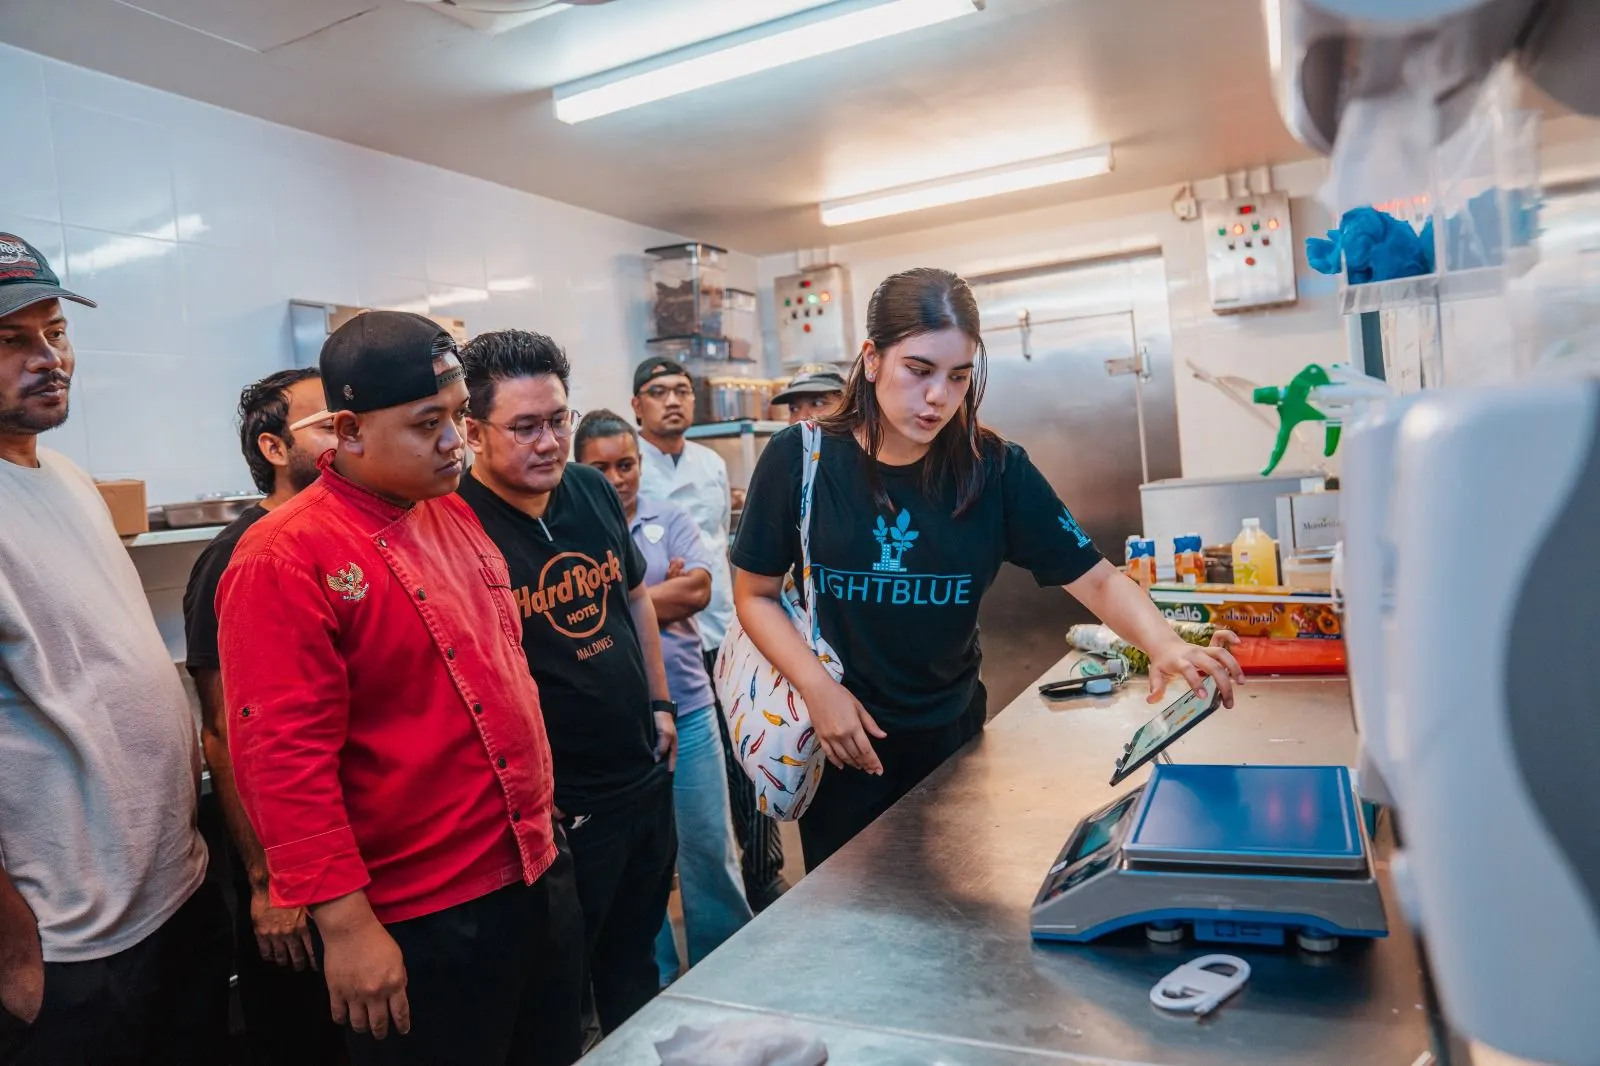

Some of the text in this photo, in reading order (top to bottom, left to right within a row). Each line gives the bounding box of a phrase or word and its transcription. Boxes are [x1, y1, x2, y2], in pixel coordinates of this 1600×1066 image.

[512, 551, 622, 617] Hard Rock
[814, 568, 972, 604] IGHTBLUE
[567, 603, 599, 625] HOTEL
[1161, 605, 1202, 621] فالكو
[576, 635, 613, 661] MALDIVES
